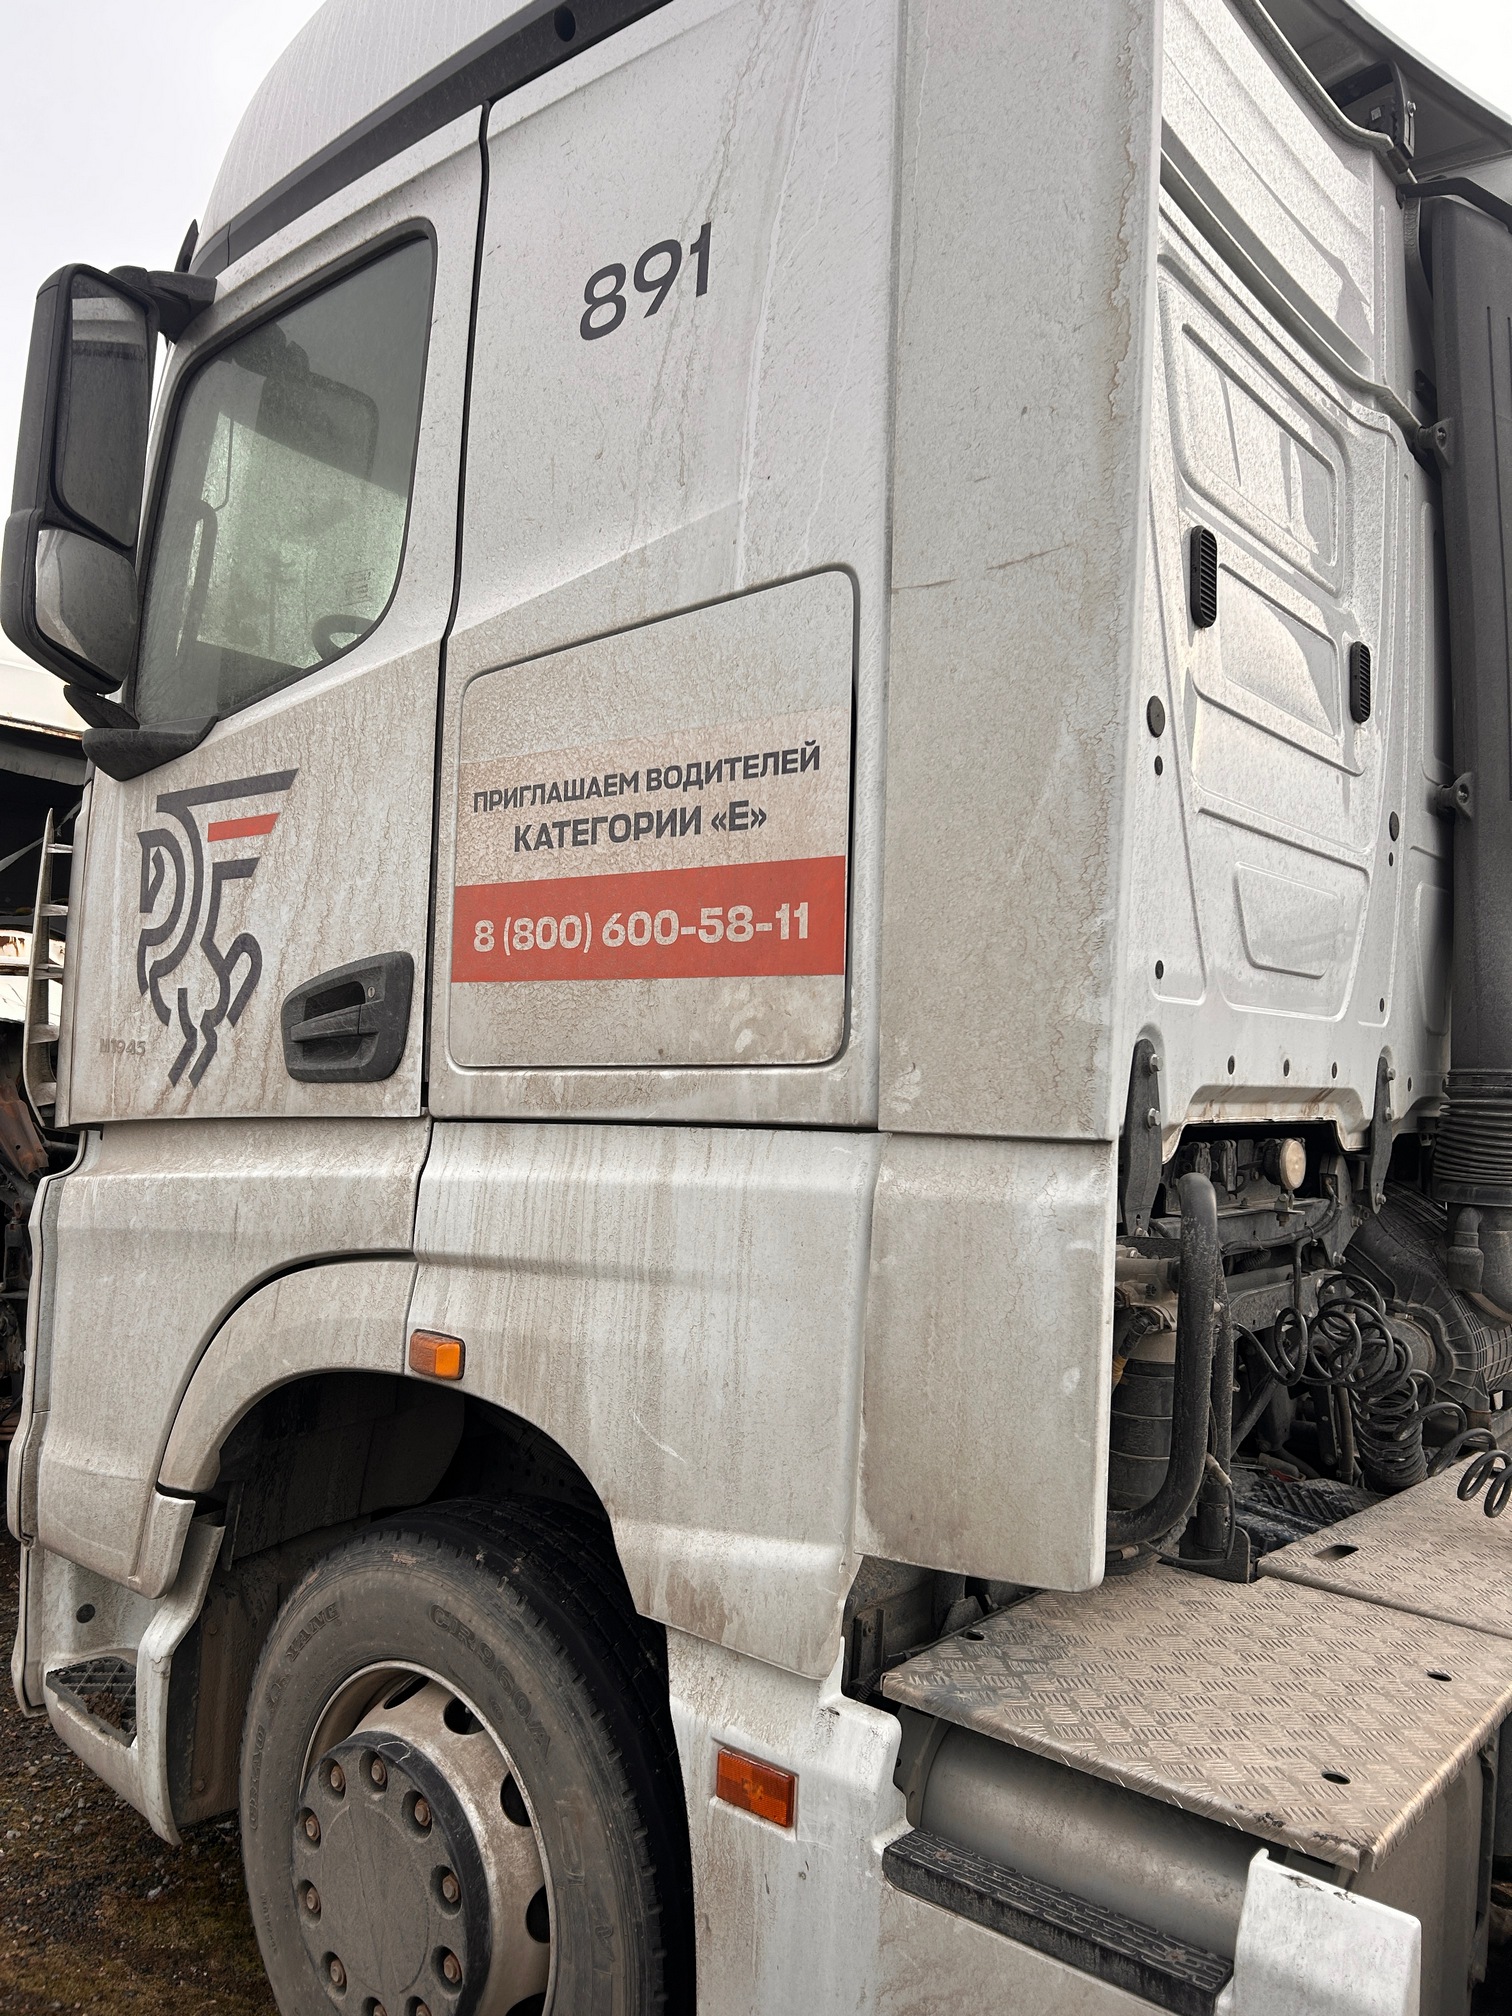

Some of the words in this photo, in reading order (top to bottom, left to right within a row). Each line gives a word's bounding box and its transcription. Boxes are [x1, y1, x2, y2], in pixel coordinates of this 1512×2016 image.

[580, 222, 711, 341] 891
[473, 770, 640, 813] ПРИГЛАШАЕМ
[645, 739, 821, 793] ВОДИТЕЛЕЙ
[514, 804, 703, 853] КАТЕГОРИИ
[710, 799, 768, 833] «Е»
[473, 919, 496, 953] 8
[503, 911, 593, 956] (800)
[601, 901, 811, 949] 600-58-11
